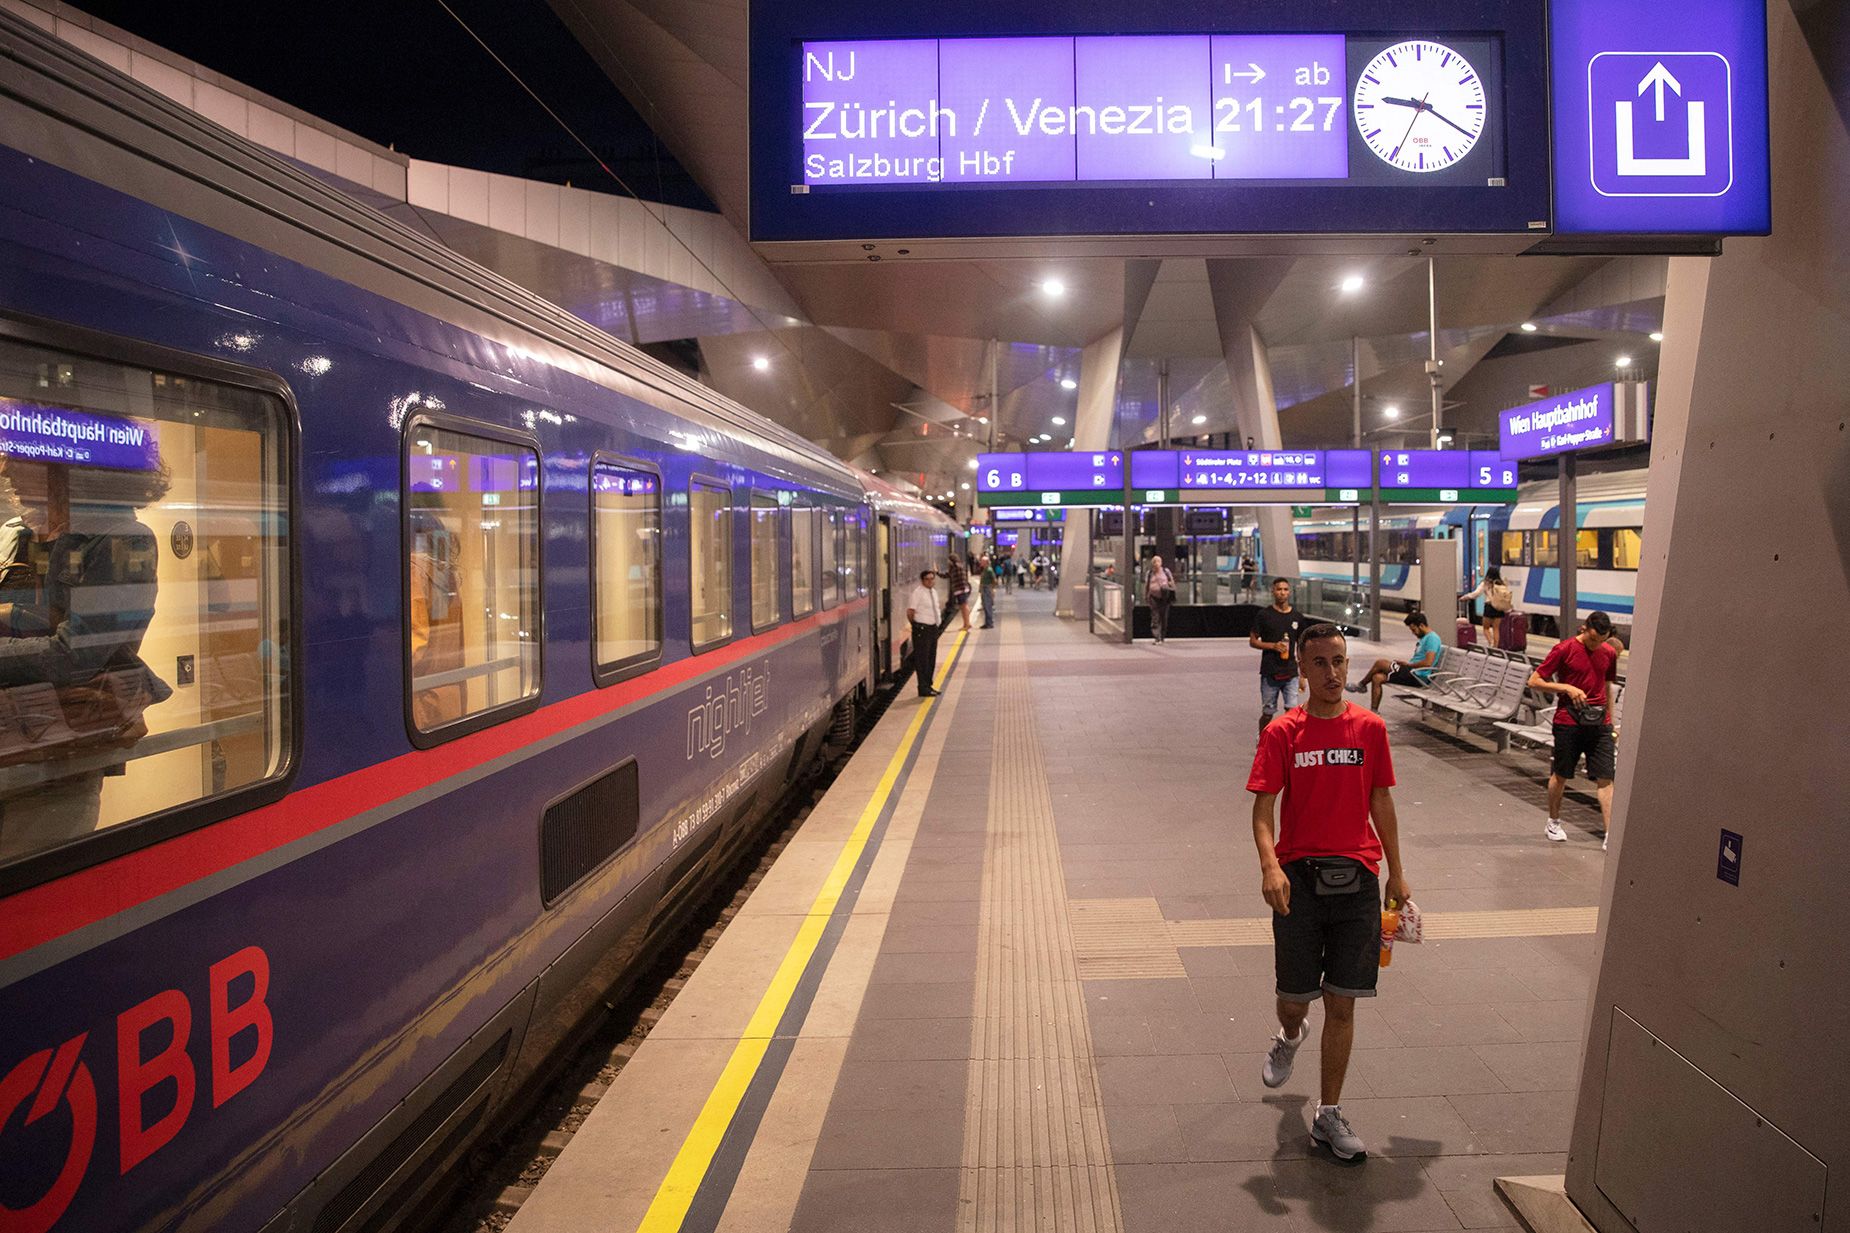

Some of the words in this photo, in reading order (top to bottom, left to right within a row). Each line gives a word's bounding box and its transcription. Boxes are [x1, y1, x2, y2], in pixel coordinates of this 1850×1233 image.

[806, 51, 855, 82] NJ
[1295, 62, 1330, 86] ab
[803, 99, 956, 140] Zürich
[1005, 96, 1194, 136] Venezia
[1215, 96, 1342, 132] 21:27
[805, 153, 945, 182] Salzburg
[960, 150, 1015, 175] Hbf
[1509, 415, 1531, 436] Wien
[1532, 394, 1599, 432] Hauptbahnhof
[987, 469, 1000, 488] 6
[1011, 473, 1022, 487] B
[1480, 467, 1491, 485] 5
[1503, 470, 1513, 485] B
[687, 659, 771, 760] nightjet
[1294, 750, 1325, 768] JUST
